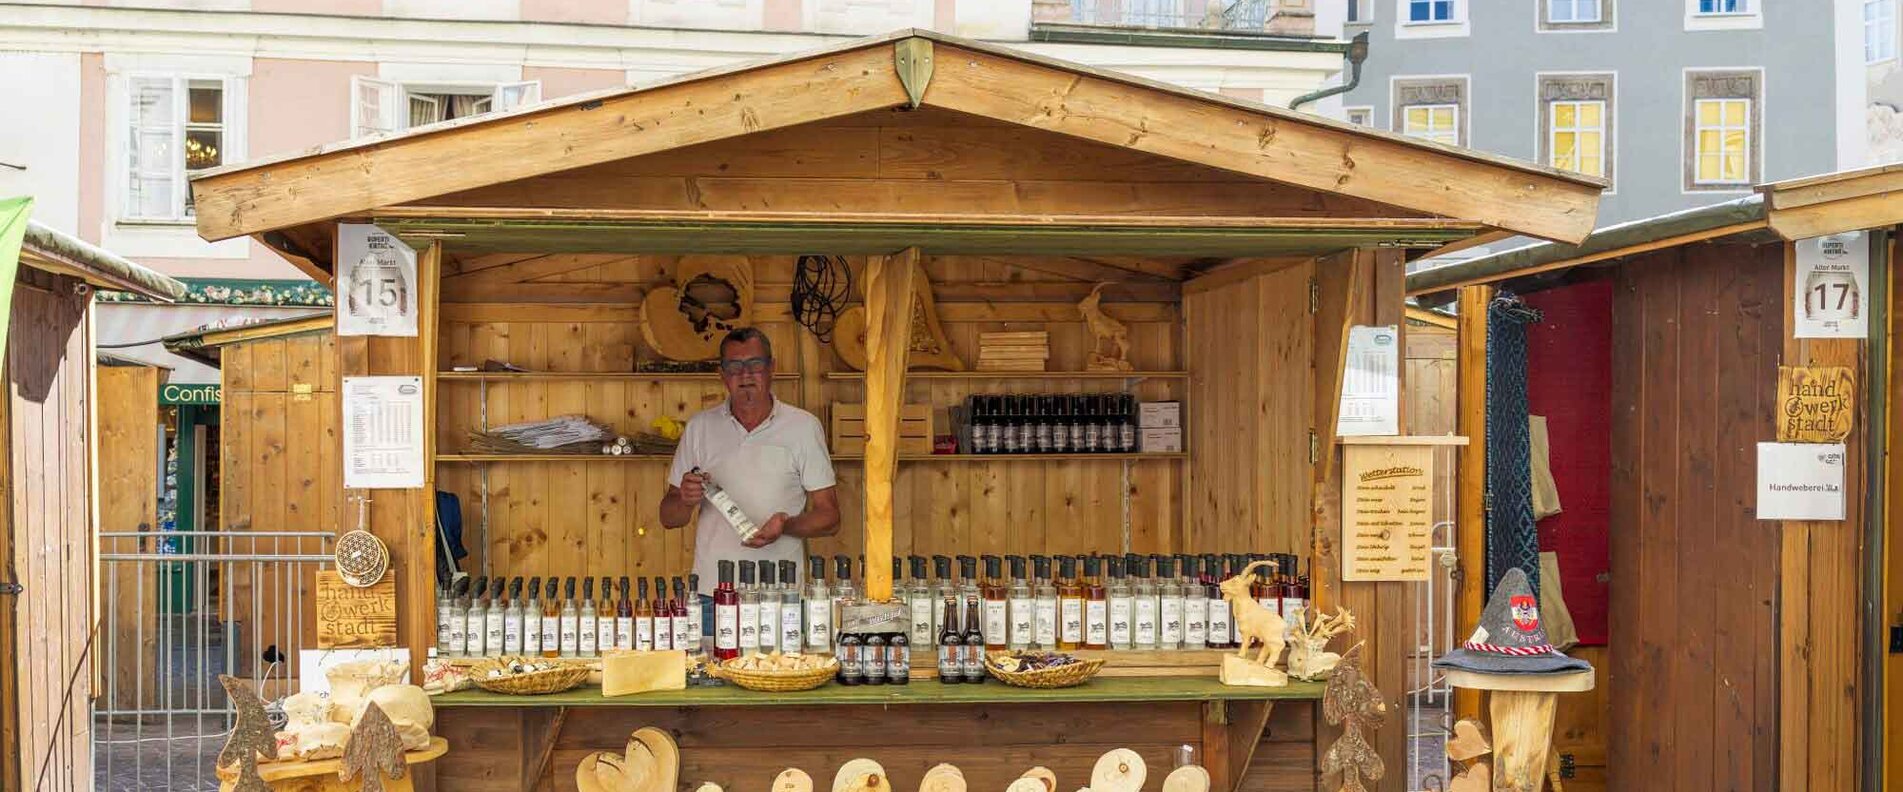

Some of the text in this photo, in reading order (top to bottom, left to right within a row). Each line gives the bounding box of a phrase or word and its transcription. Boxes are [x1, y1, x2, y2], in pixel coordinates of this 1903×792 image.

[360, 278, 397, 306] 15
[1814, 283, 1850, 310] 17
[1788, 378, 1836, 397] hand
[1803, 395, 1848, 415] werk
[1787, 415, 1836, 433] stadt
[1358, 466, 1424, 481] Wetterstation
[1769, 483, 1825, 492] Handweberei
[321, 582, 376, 600] hand
[342, 597, 391, 619] werk
[326, 617, 376, 635] stadt
